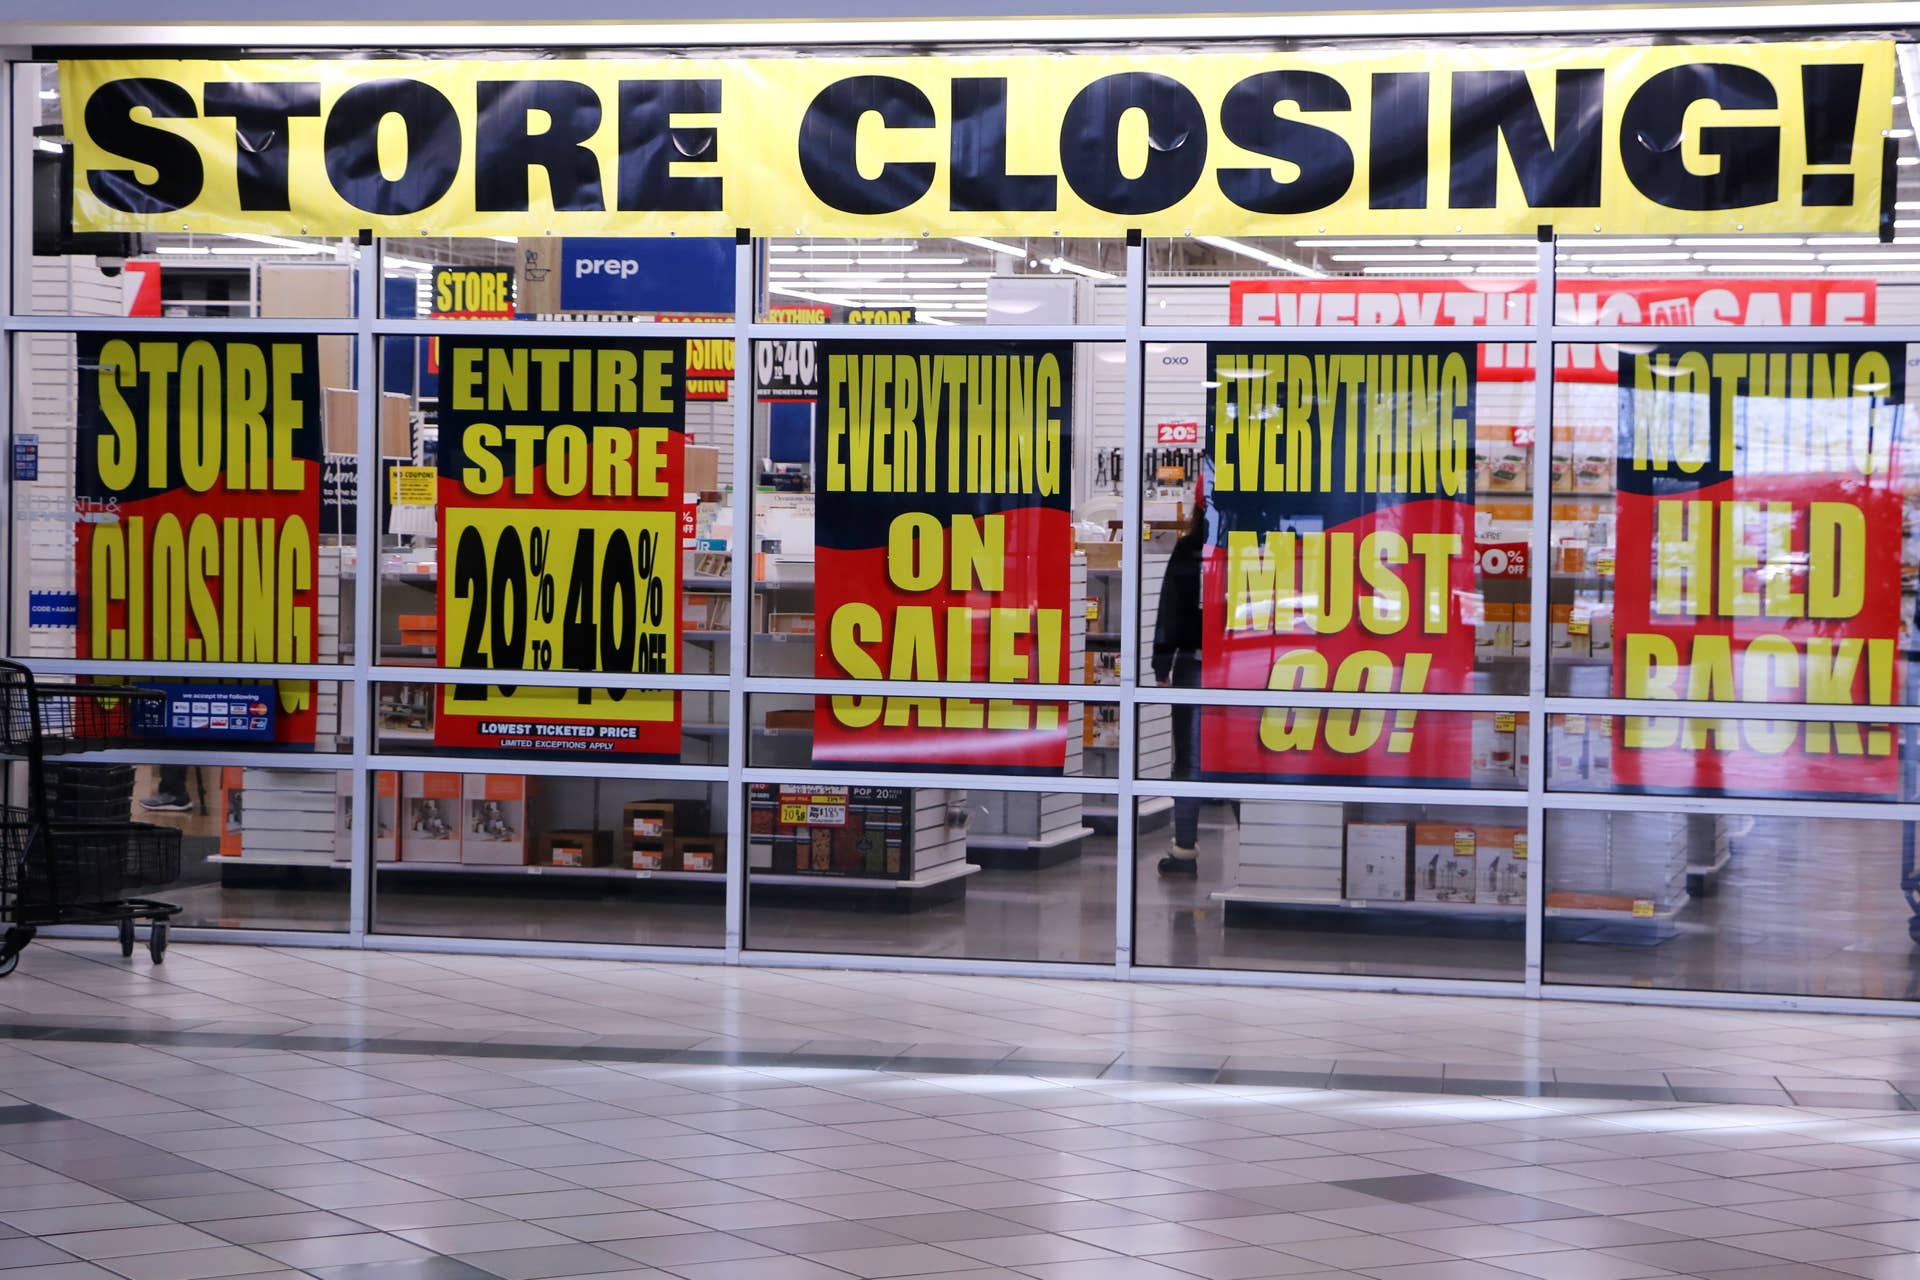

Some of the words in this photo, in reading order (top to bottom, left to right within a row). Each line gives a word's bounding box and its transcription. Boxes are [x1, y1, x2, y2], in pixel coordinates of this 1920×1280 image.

[84, 78, 723, 215] STORE
[798, 63, 1864, 215] CLOSING!
[437, 271, 508, 312] STORE
[575, 258, 639, 279] prep
[452, 348, 674, 413] ENTIRE
[784, 341, 817, 386] 40
[1162, 356, 1189, 365] OXO
[97, 339, 305, 492] STORE
[826, 353, 1061, 497] EVERYTHING
[1214, 352, 1468, 496] EVERYTHING
[1633, 350, 1891, 475] NOTHING
[462, 423, 669, 497] STORE
[888, 511, 1005, 592] ON
[1226, 530, 1462, 635] MUST
[1508, 564, 1525, 574] OFF
[1655, 500, 1866, 618] HELD
[453, 525, 555, 701] 20%
[563, 528, 663, 704] 40%
[229, 693, 260, 701] following
[830, 602, 1062, 730] SALE!
[1259, 649, 1433, 753] GO!
[1624, 634, 1894, 756] BACK!
[481, 723, 533, 736] LOWEST
[536, 725, 595, 737] TICKETED
[599, 726, 638, 738] PRICE
[500, 739, 533, 748] LIMITED
[535, 740, 587, 749] EXCEPTIONS
[589, 741, 614, 751] APPLY
[876, 789, 889, 799] 20
